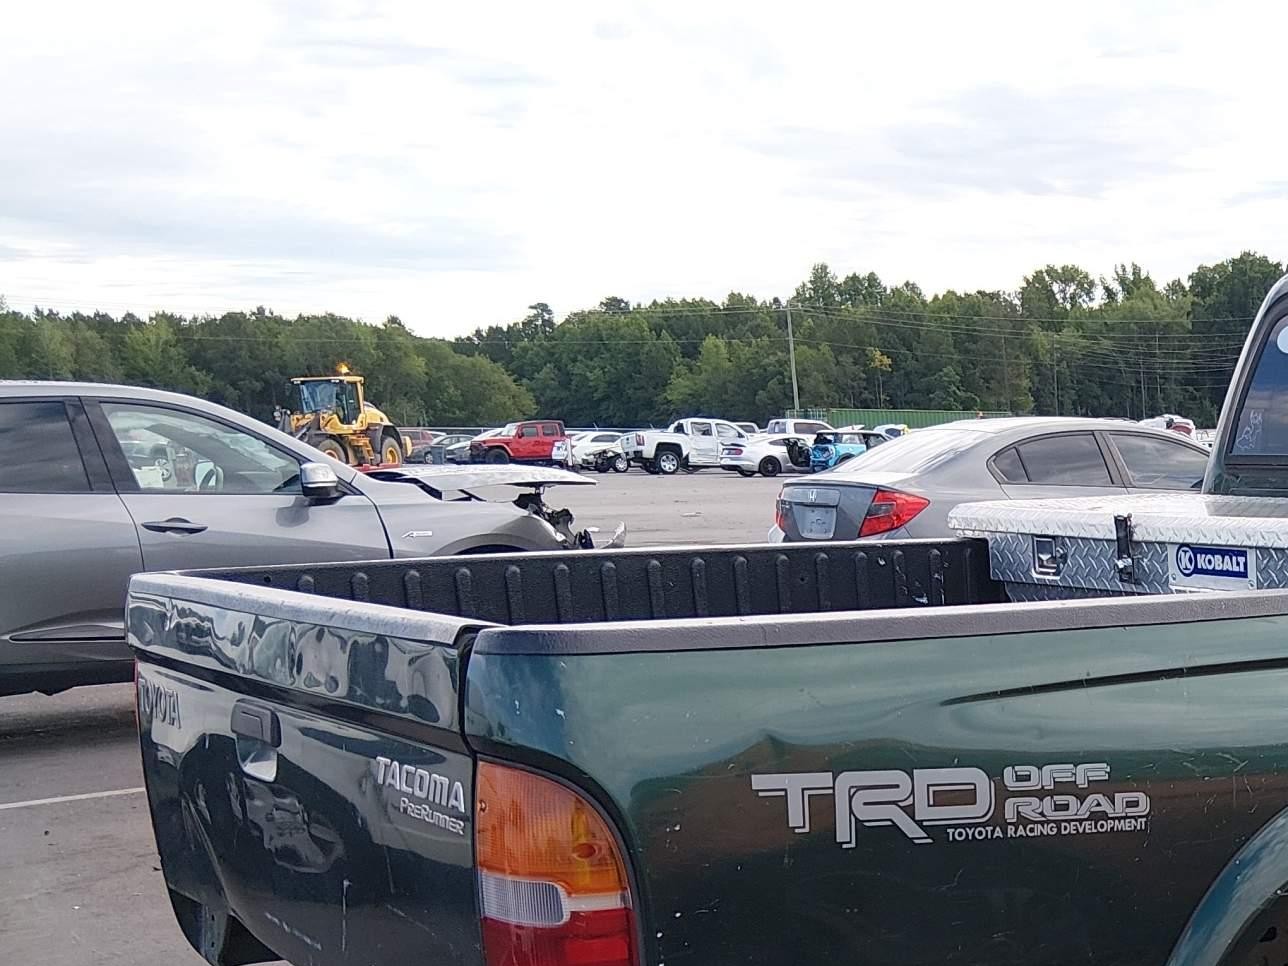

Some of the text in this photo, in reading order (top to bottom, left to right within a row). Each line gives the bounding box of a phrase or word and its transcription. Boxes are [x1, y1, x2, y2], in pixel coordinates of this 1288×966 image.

[1196, 553, 1246, 573] KOBALT
[375, 755, 465, 813] TACOMA
[1003, 762, 1111, 790] OFF
[751, 767, 995, 849] TRD
[1004, 791, 1150, 823] ROAD
[947, 817, 1147, 842] TOYOTA RACING DEVELOPMENT
